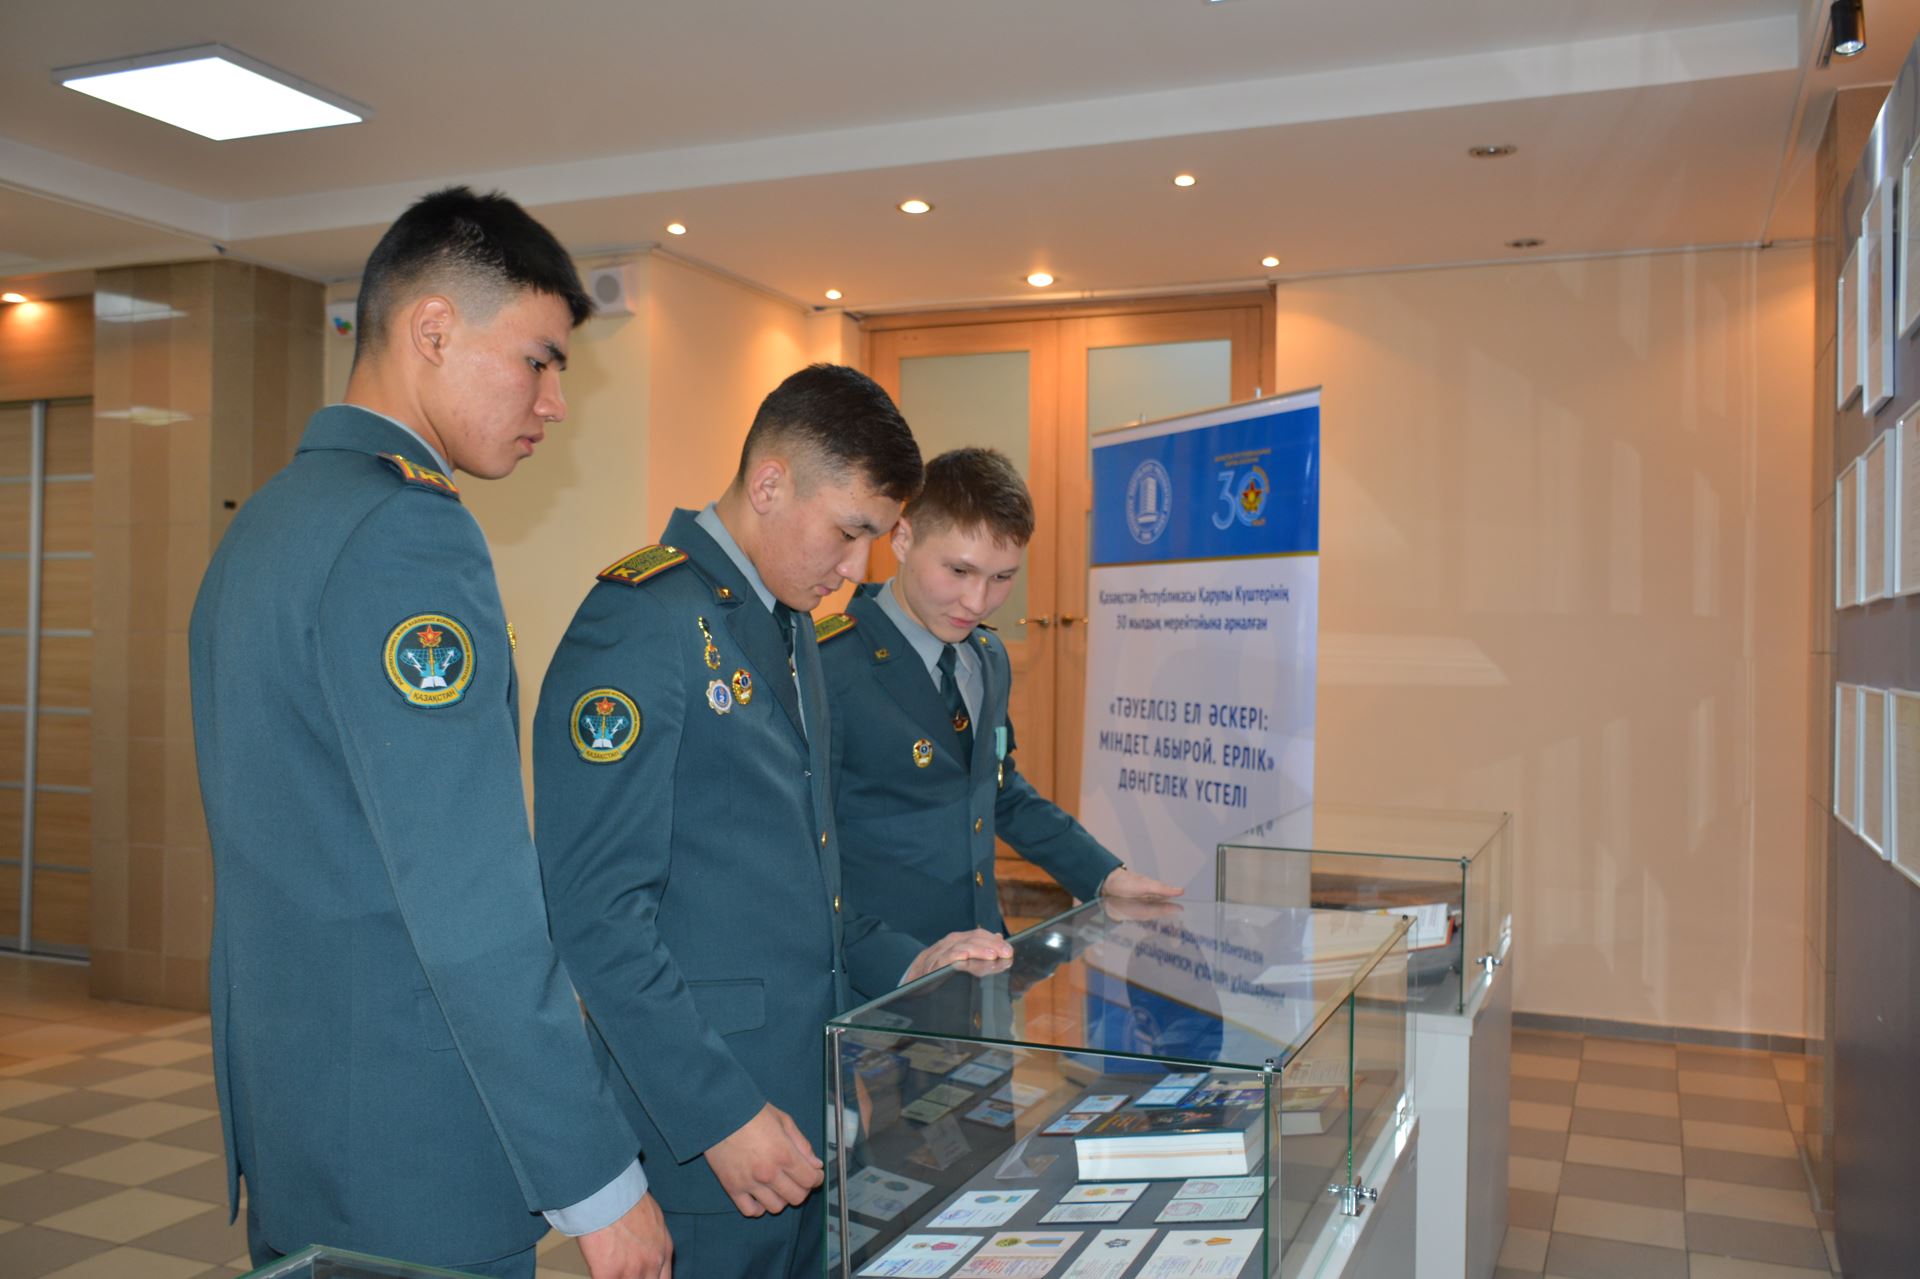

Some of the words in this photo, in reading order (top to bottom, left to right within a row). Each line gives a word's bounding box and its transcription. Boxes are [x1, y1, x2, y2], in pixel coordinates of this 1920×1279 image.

[1212, 469, 1268, 530] 30
[1139, 588, 1196, 606] Республикасы
[1198, 585, 1232, 606] Қарулы
[1117, 614, 1127, 630] 30
[1223, 616, 1268, 634] арналған
[1110, 696, 1177, 723] «ТӘУЕЛСІЗ
[1184, 701, 1202, 724] ЕЛ
[1208, 703, 1269, 731] ӘСКЕРІ:
[1154, 736, 1217, 765] АБЫРОЙ.
[1223, 744, 1275, 771] ЕРЛІК»
[1118, 768, 1188, 799] ДӨҢГЕЛЕК
[1195, 778, 1247, 808] ҮСТЕЛІ
